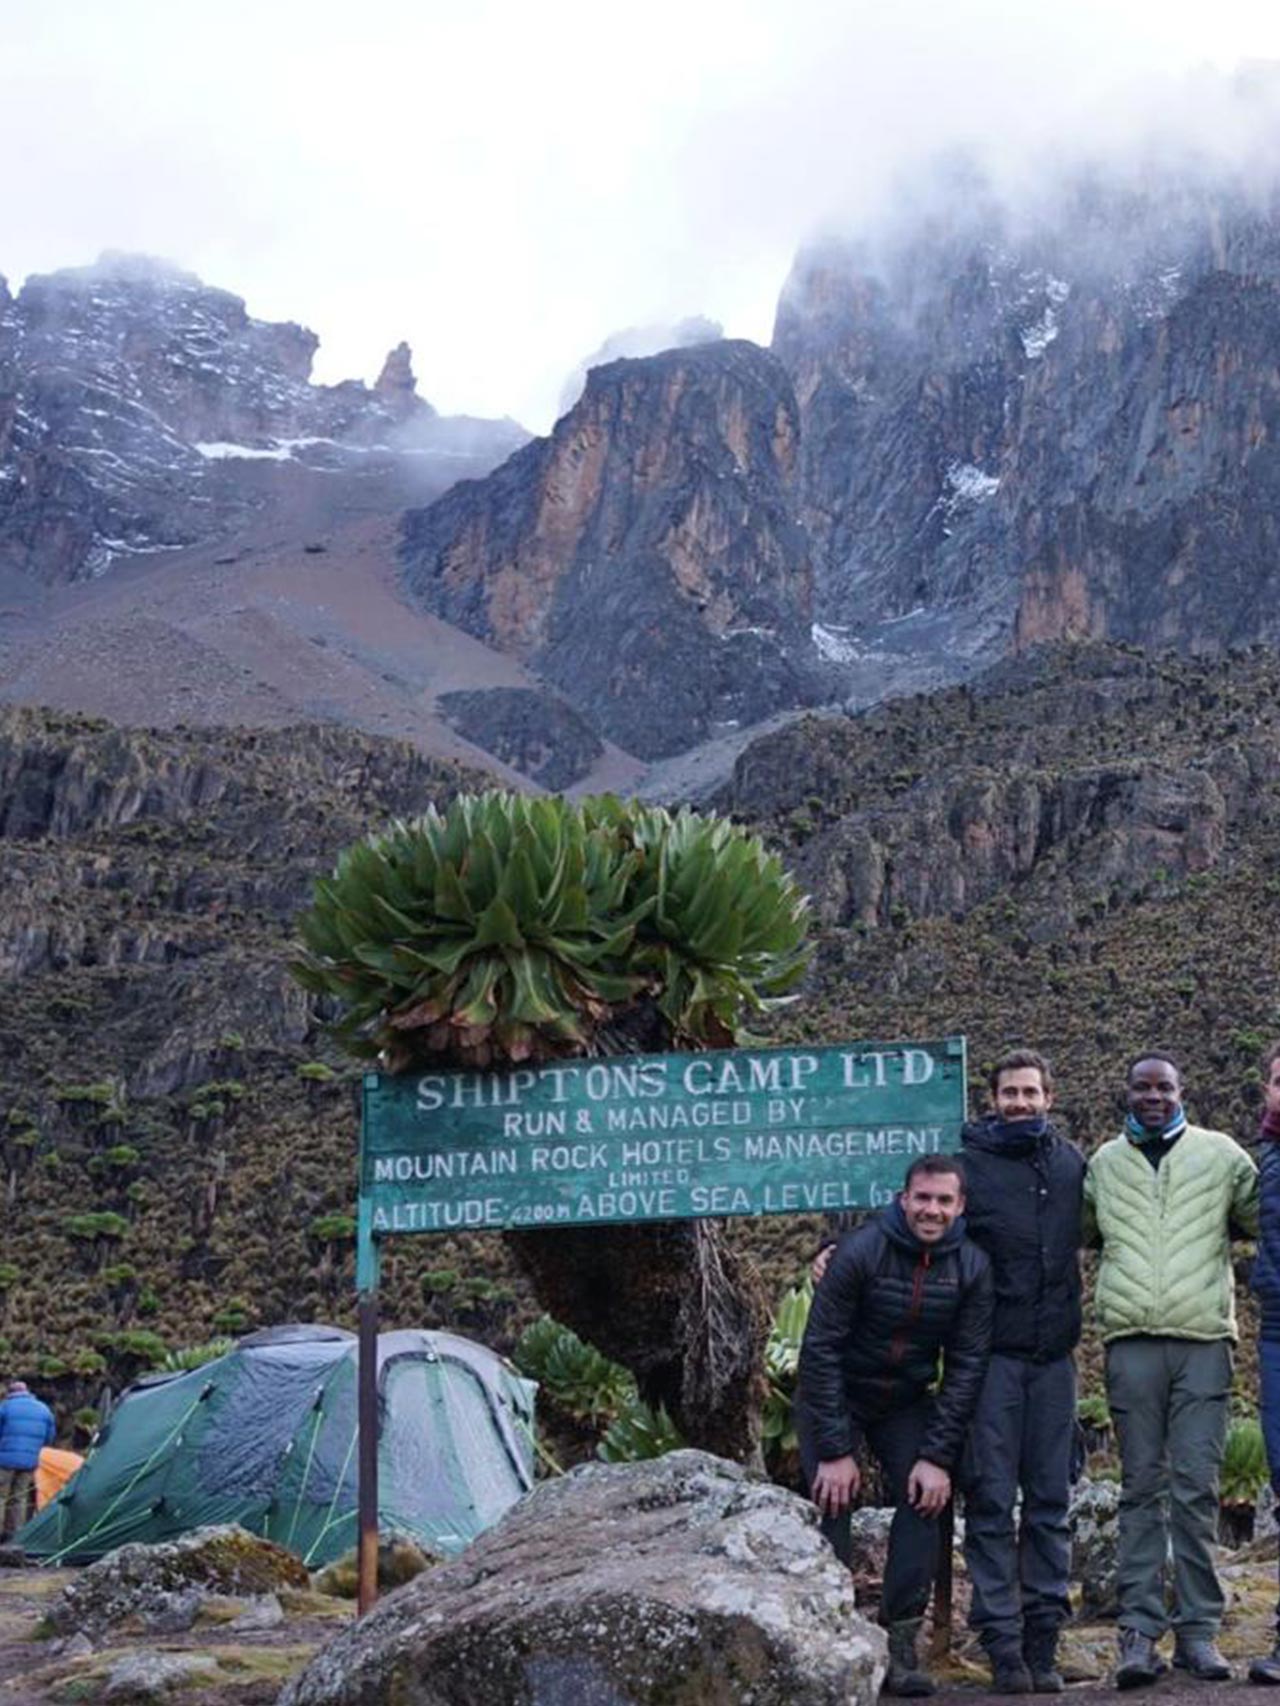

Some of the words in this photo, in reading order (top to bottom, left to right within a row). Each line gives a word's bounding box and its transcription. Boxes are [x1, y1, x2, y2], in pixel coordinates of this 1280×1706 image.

[683, 1054, 819, 1096] CAMP
[842, 1049, 934, 1088] LTD
[503, 1110, 567, 1138] RUN
[575, 1108, 593, 1133] &
[608, 1100, 750, 1132] MANAGED
[374, 1149, 518, 1182] MOUNTAIN
[531, 1143, 608, 1172] ROCK
[622, 1137, 731, 1166] HOTELS
[745, 1127, 943, 1160] MANAGEMENT
[608, 1168, 689, 1188] LIMITED
[576, 1189, 677, 1218] ABOVE
[690, 1185, 750, 1213] SEA
[764, 1182, 858, 1210] LEVEL
